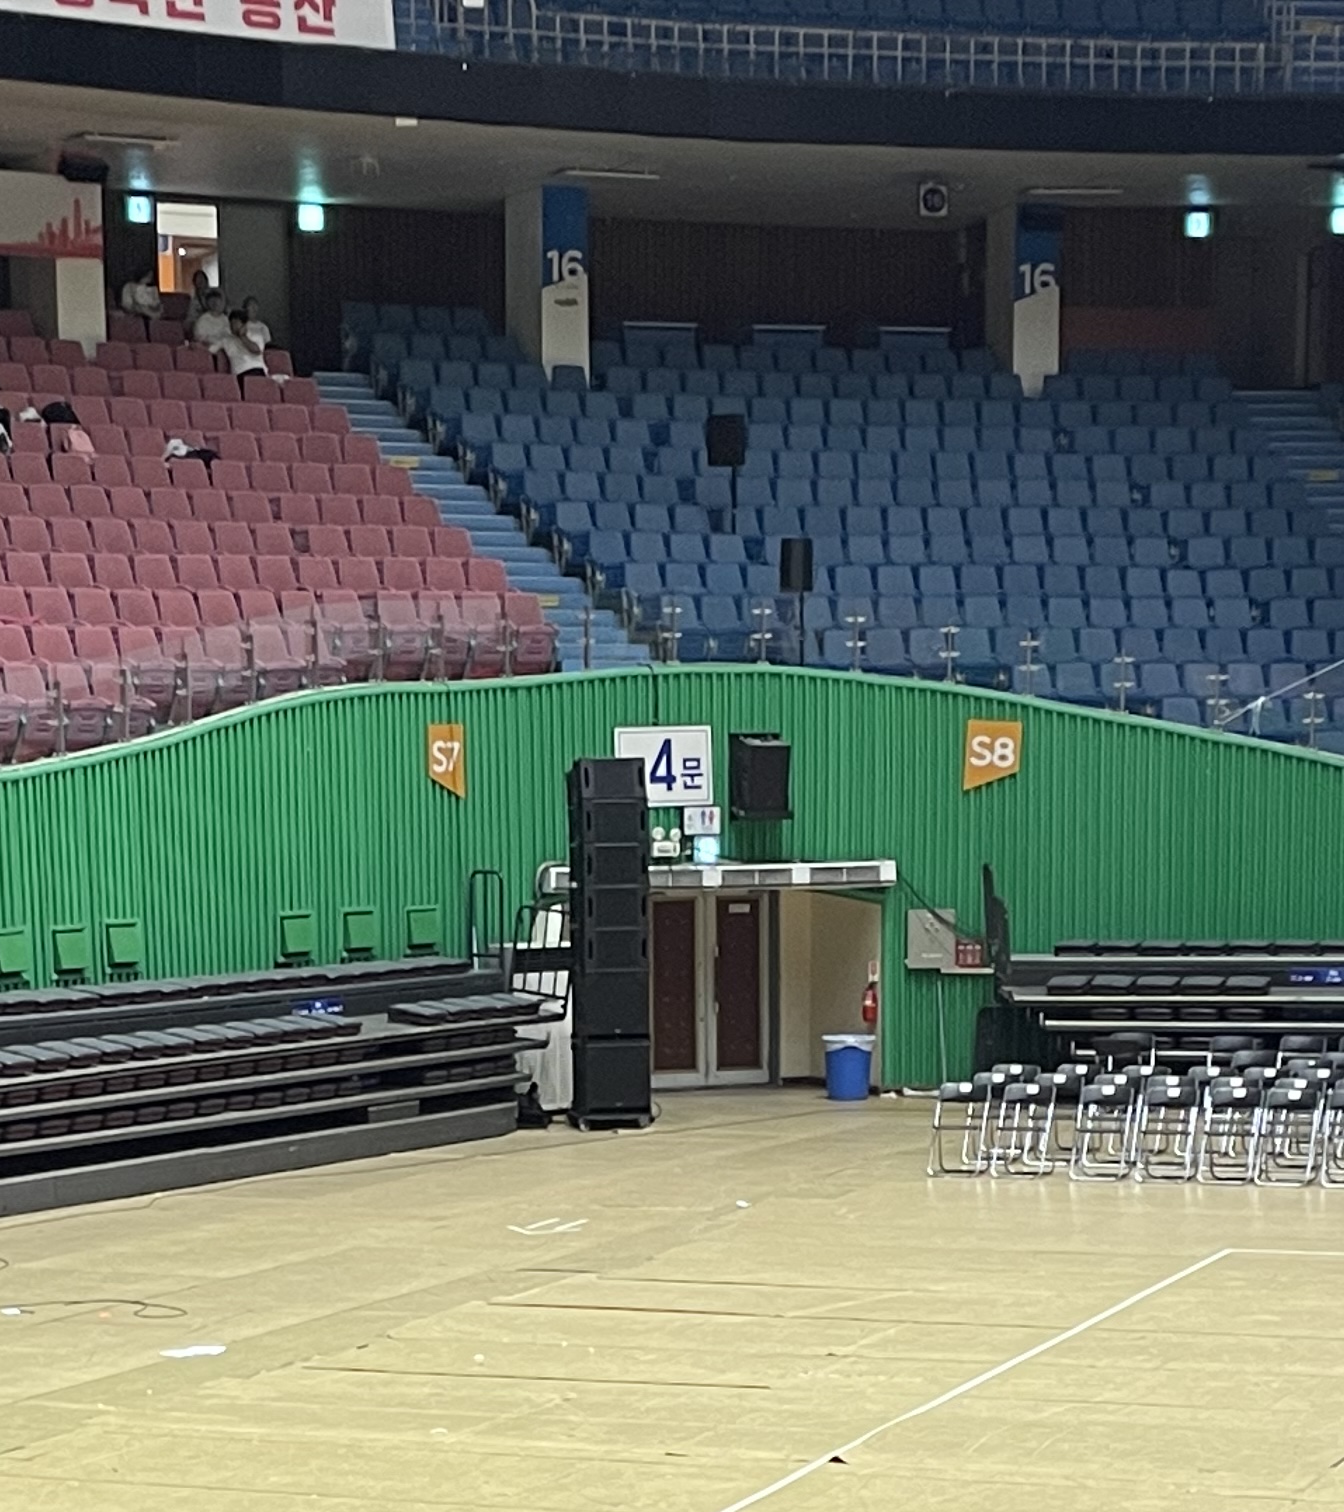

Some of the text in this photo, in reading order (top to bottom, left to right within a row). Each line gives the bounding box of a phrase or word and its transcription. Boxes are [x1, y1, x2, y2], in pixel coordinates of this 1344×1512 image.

[547, 249, 584, 284] 16
[1019, 262, 1056, 294] 16
[432, 740, 460, 773] S7
[969, 735, 1016, 769] S8
